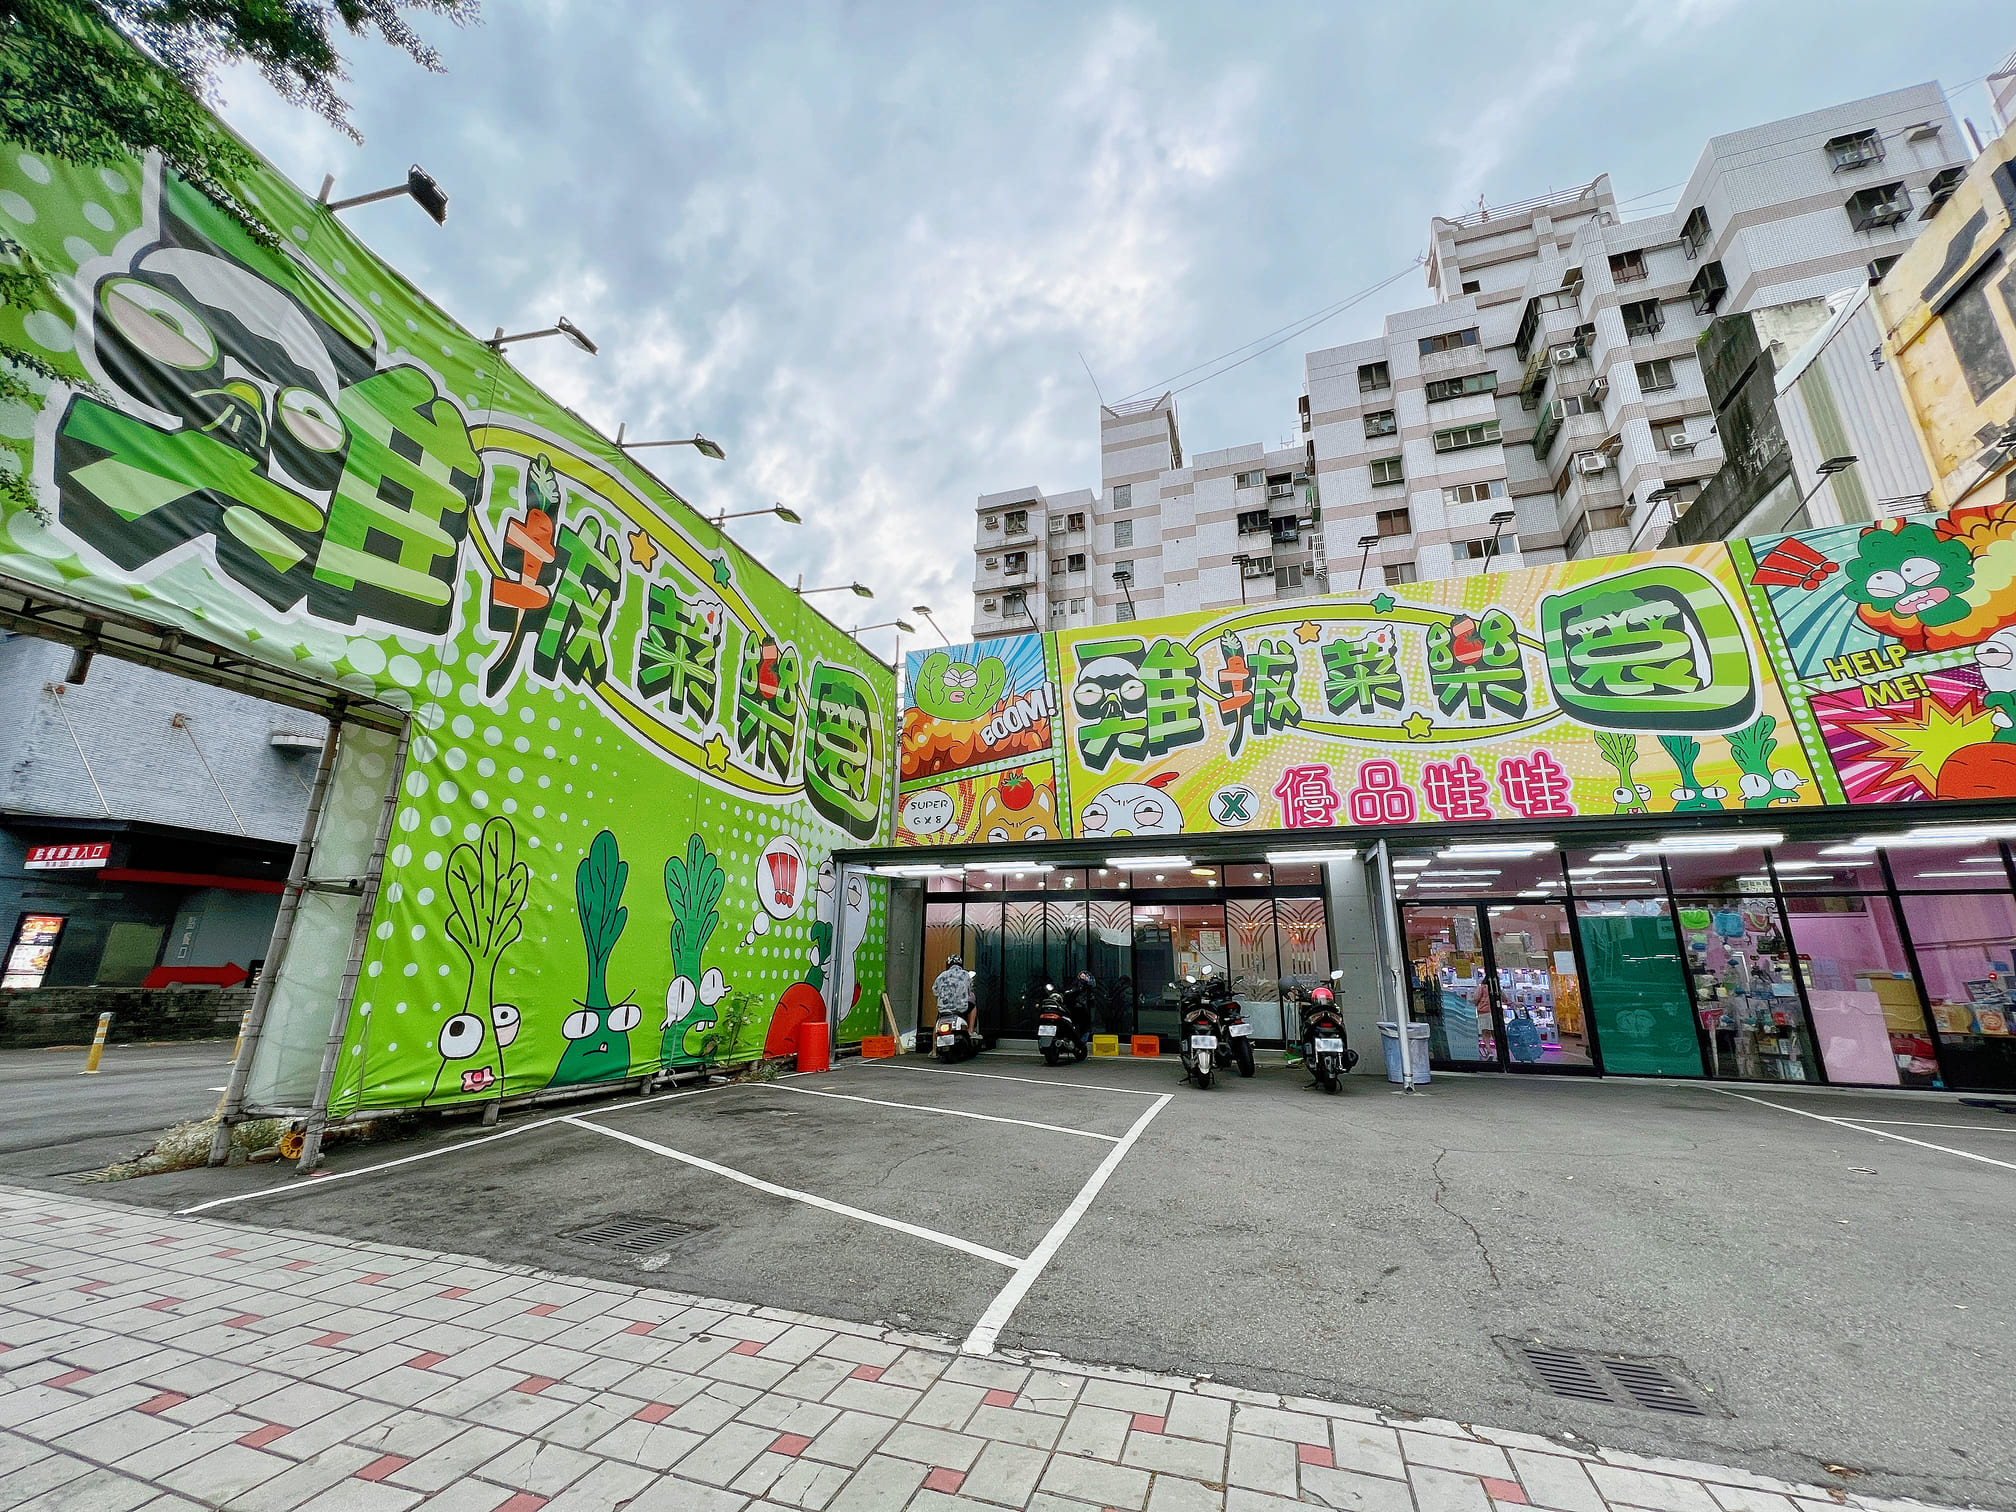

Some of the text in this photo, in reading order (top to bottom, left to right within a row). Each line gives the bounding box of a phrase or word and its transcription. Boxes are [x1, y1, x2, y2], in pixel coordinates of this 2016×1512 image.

[1824, 644, 1908, 682] HELP
[1861, 673, 1932, 709] ME!
[980, 681, 1057, 746] BOOM!
[910, 799, 949, 811] SUPER
[1275, 752, 1575, 828] 優品娃娃
